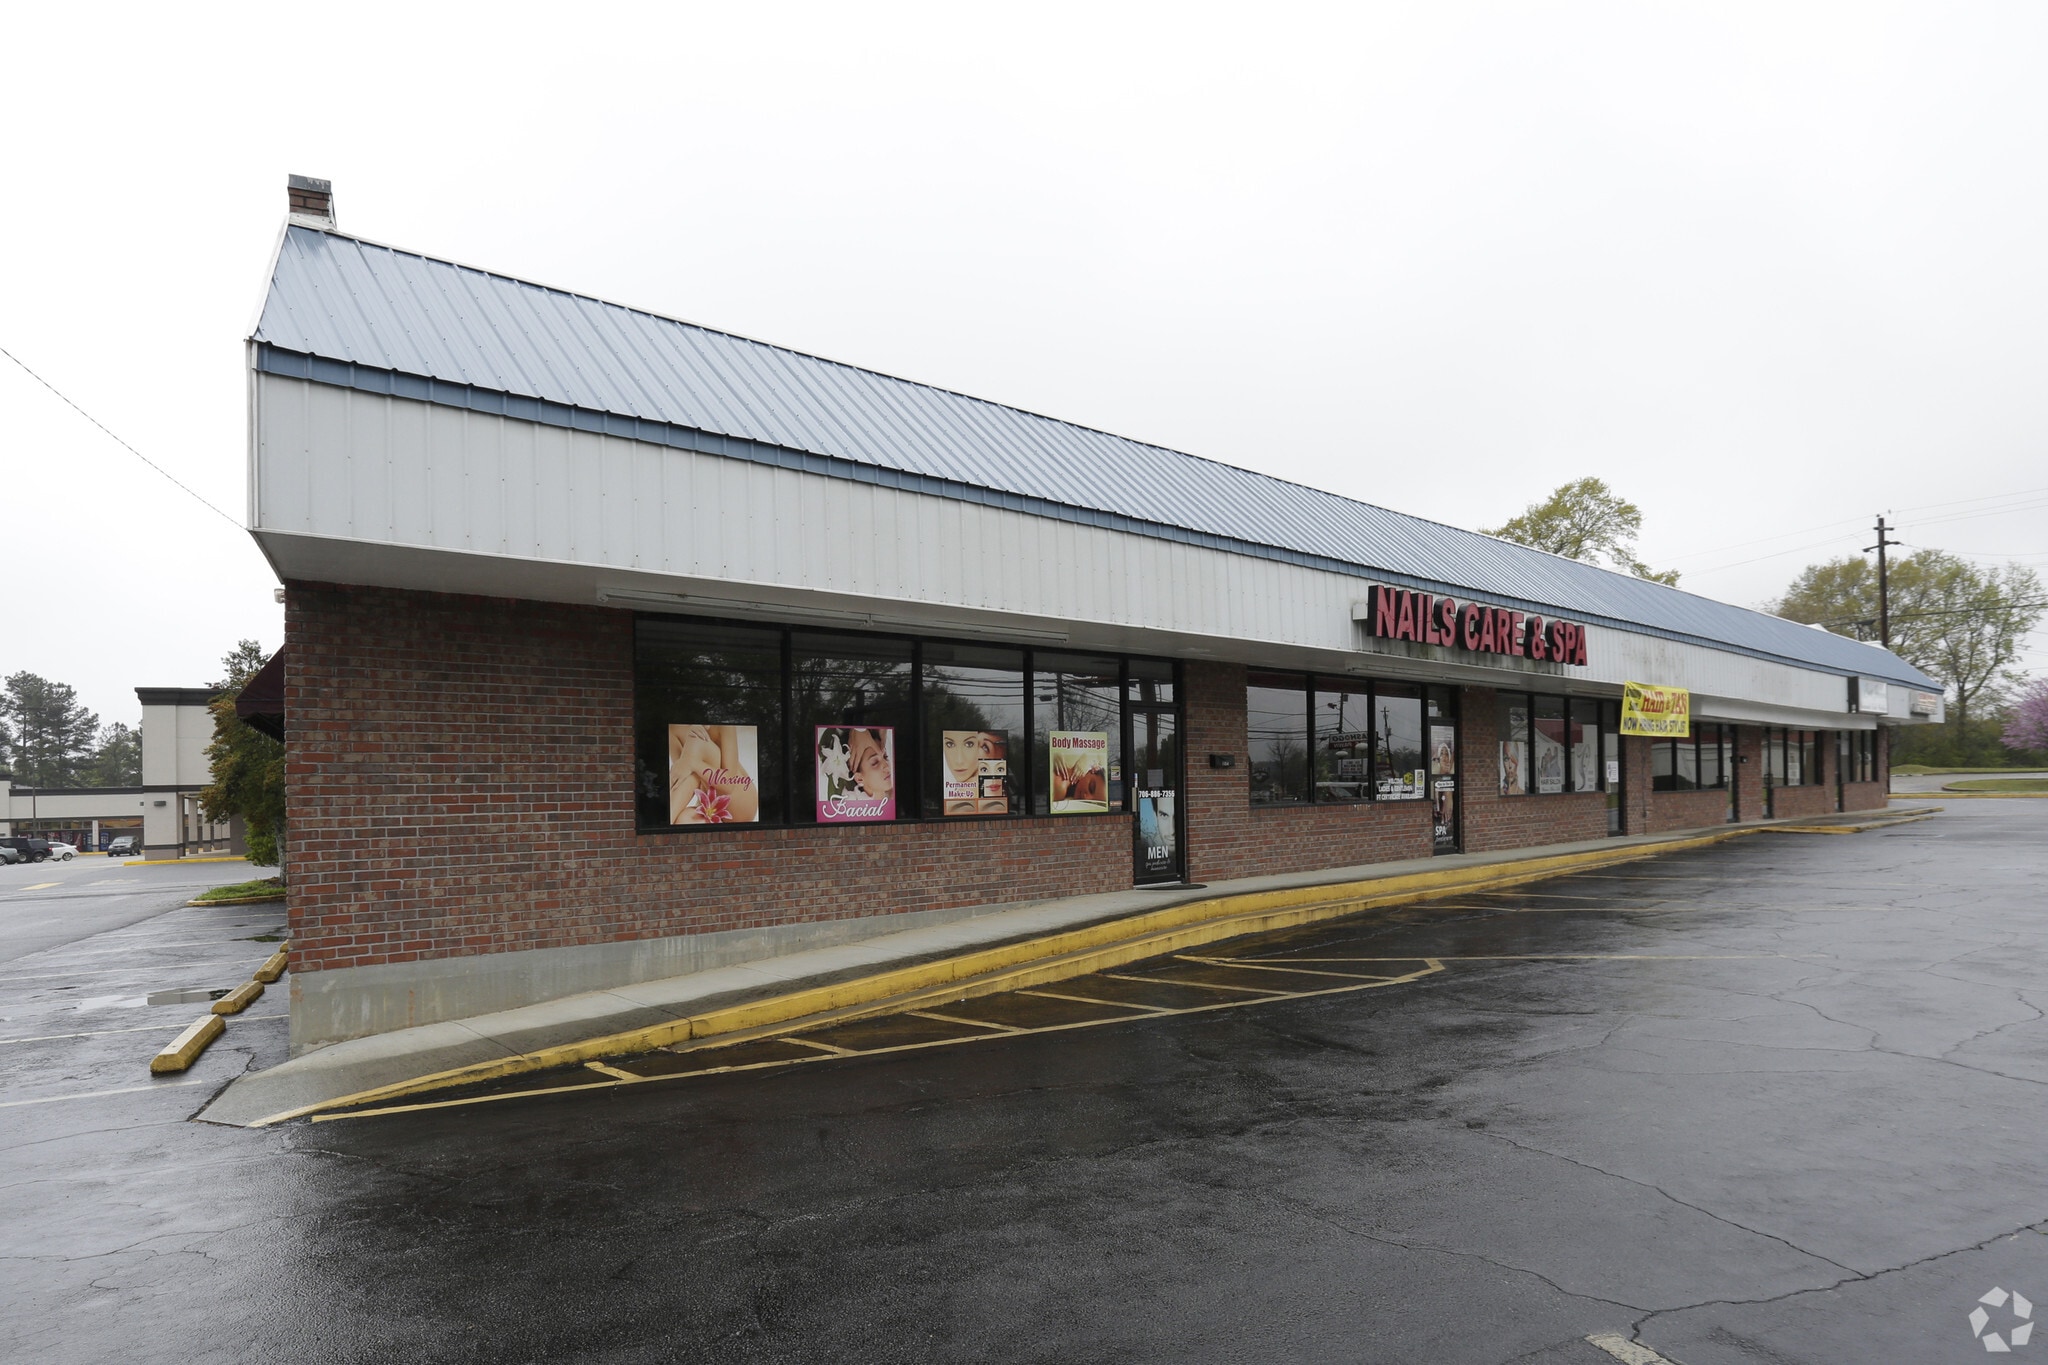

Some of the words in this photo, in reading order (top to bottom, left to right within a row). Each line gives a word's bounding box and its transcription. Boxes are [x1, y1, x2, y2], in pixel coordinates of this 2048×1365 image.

[1373, 585, 1456, 647] NAILS
[1462, 602, 1524, 656] CARE
[1530, 616, 1546, 660] &
[1552, 620, 1587, 666] SPA
[1641, 690, 1665, 713] HAIR
[1623, 716, 1638, 731] NOW
[1052, 736, 1071, 750] Body
[1072, 737, 1106, 750] Massage
[702, 768, 753, 792] Waxing
[945, 781, 977, 789] Permanent
[948, 790, 975, 798] Make-Up
[823, 795, 888, 818] Facial
[1435, 826, 1446, 835] SPA
[1147, 846, 1169, 859] MEN
